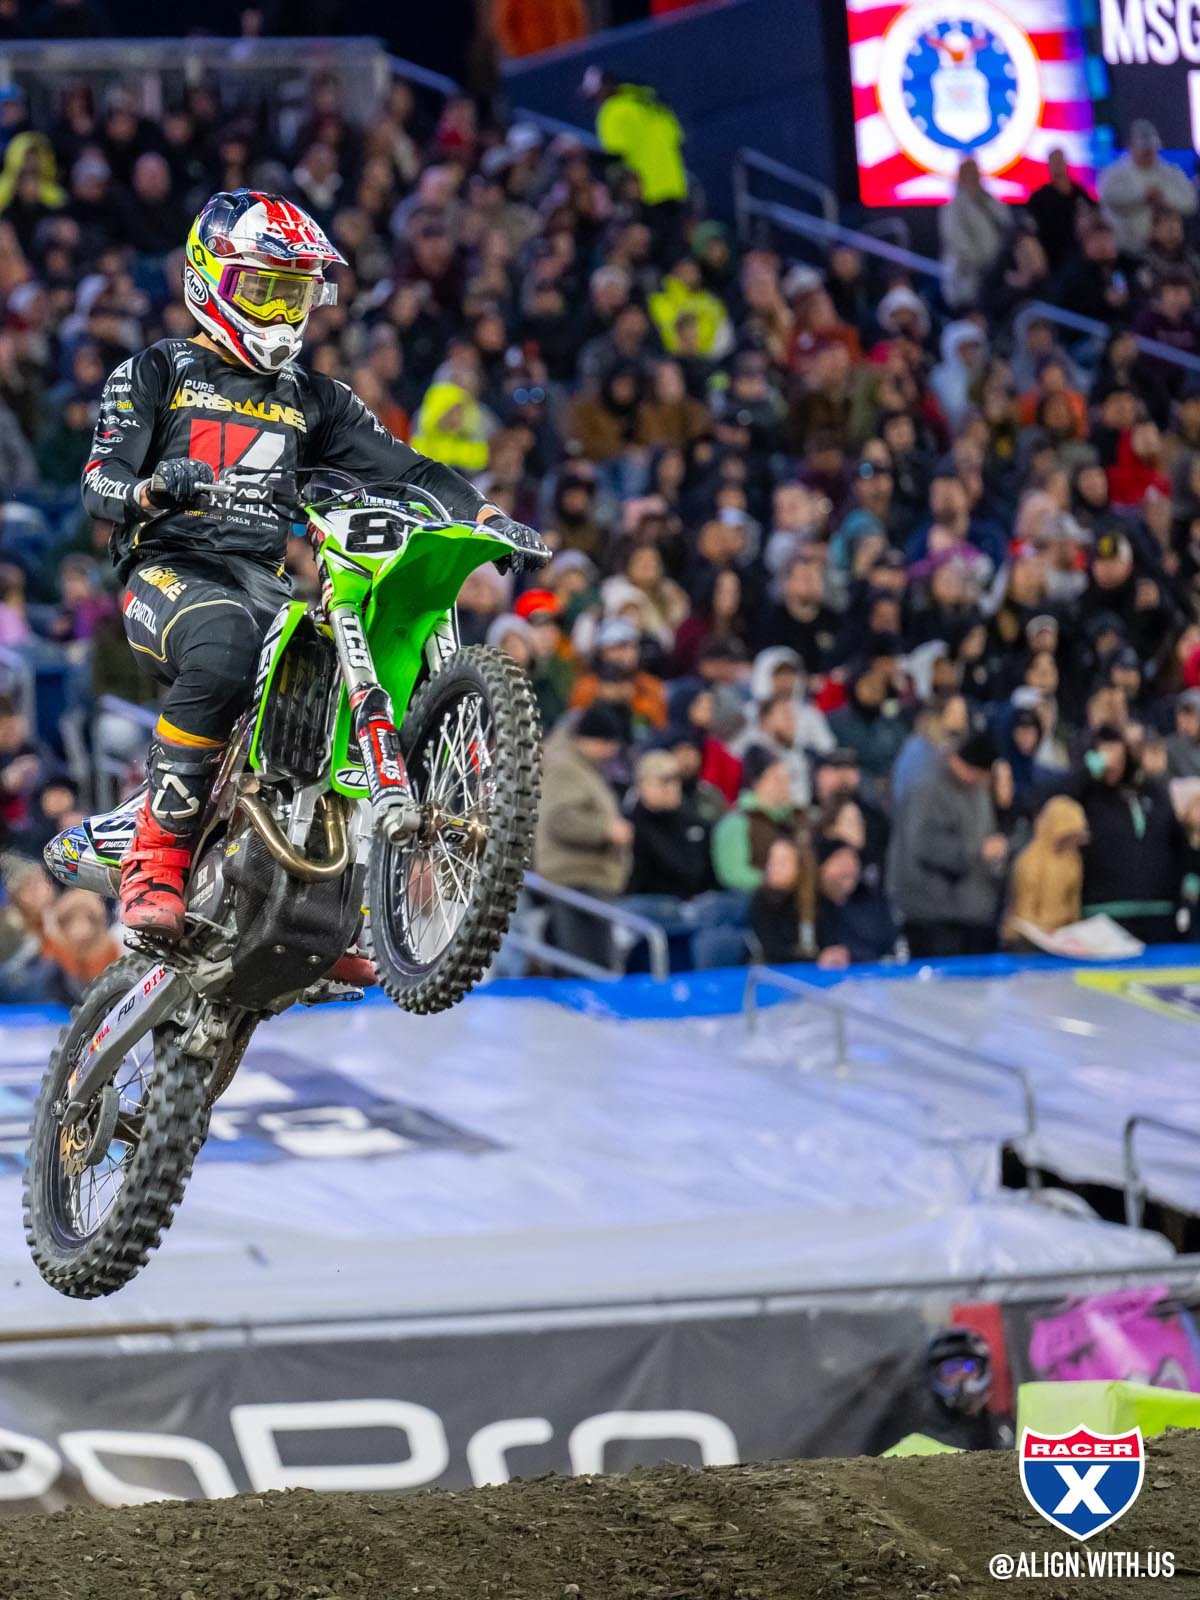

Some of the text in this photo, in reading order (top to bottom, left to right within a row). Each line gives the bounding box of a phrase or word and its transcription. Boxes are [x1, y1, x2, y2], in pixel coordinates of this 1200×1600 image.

[187, 269, 208, 302] Arai
[184, 379, 215, 393] PURE
[169, 387, 307, 433] ADRENALINE
[237, 488, 269, 499] ASV
